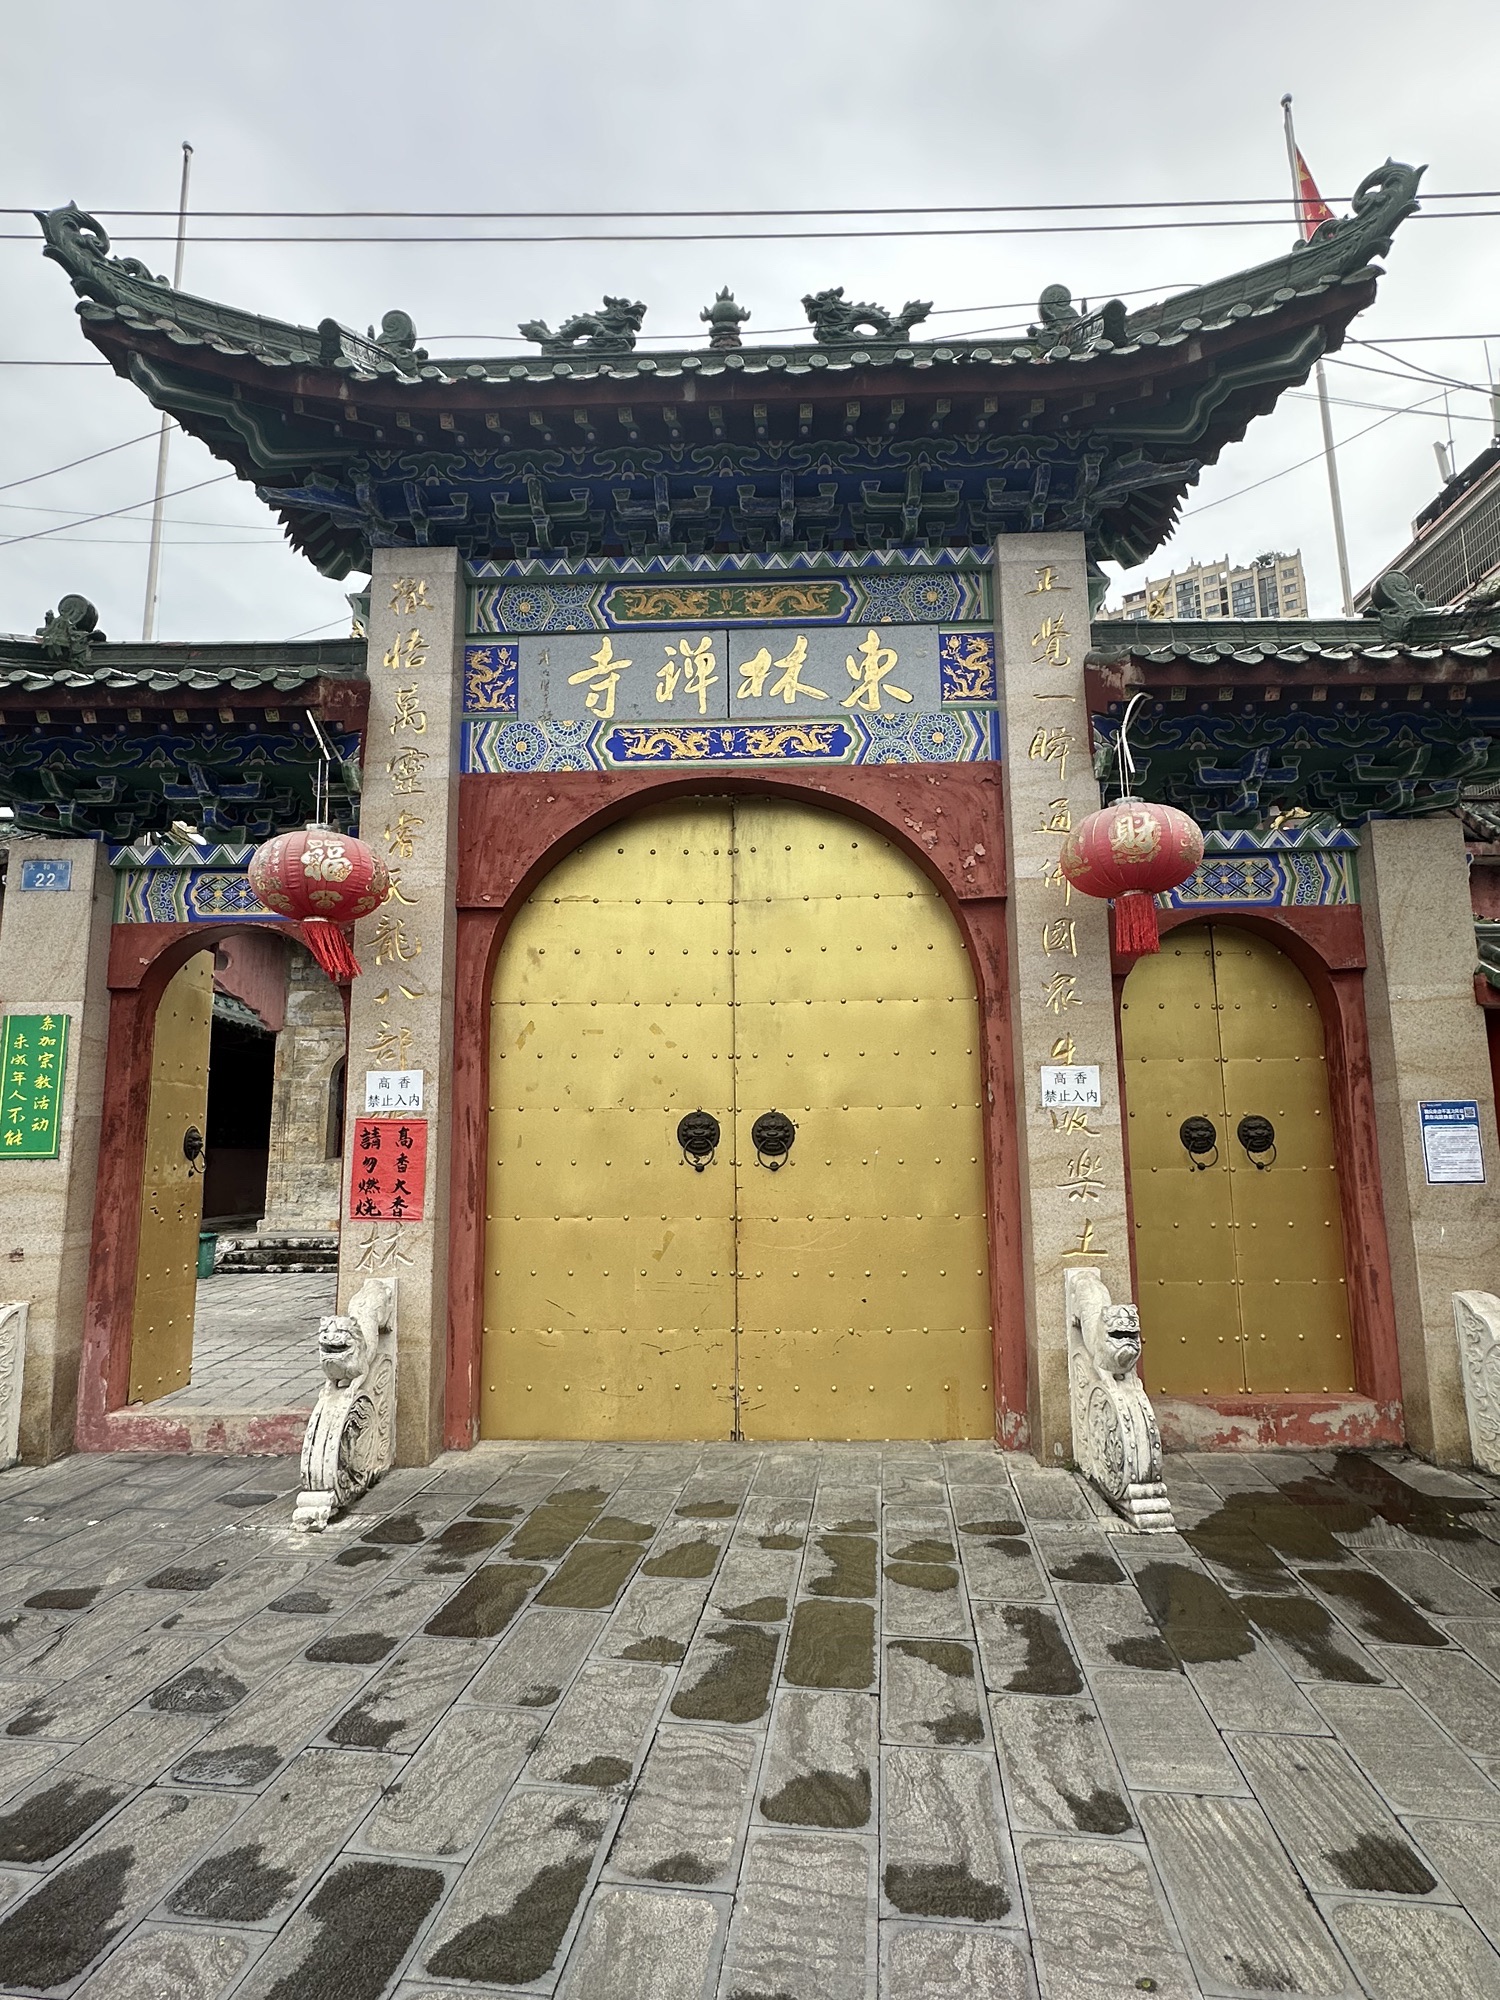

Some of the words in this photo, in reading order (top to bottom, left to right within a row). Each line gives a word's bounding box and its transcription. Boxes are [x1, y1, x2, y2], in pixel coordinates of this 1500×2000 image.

[301, 839, 353, 882] 福
[35, 873, 56, 887] 22
[31, 1015, 57, 1132] 参加宗教活动
[1054, 1072, 1087, 1084] 高香
[4, 1033, 29, 1146] 未成年人不能
[378, 1076, 411, 1089] 高香
[368, 1094, 420, 1108] 禁止入内
[1045, 1090, 1098, 1103] 禁止入内
